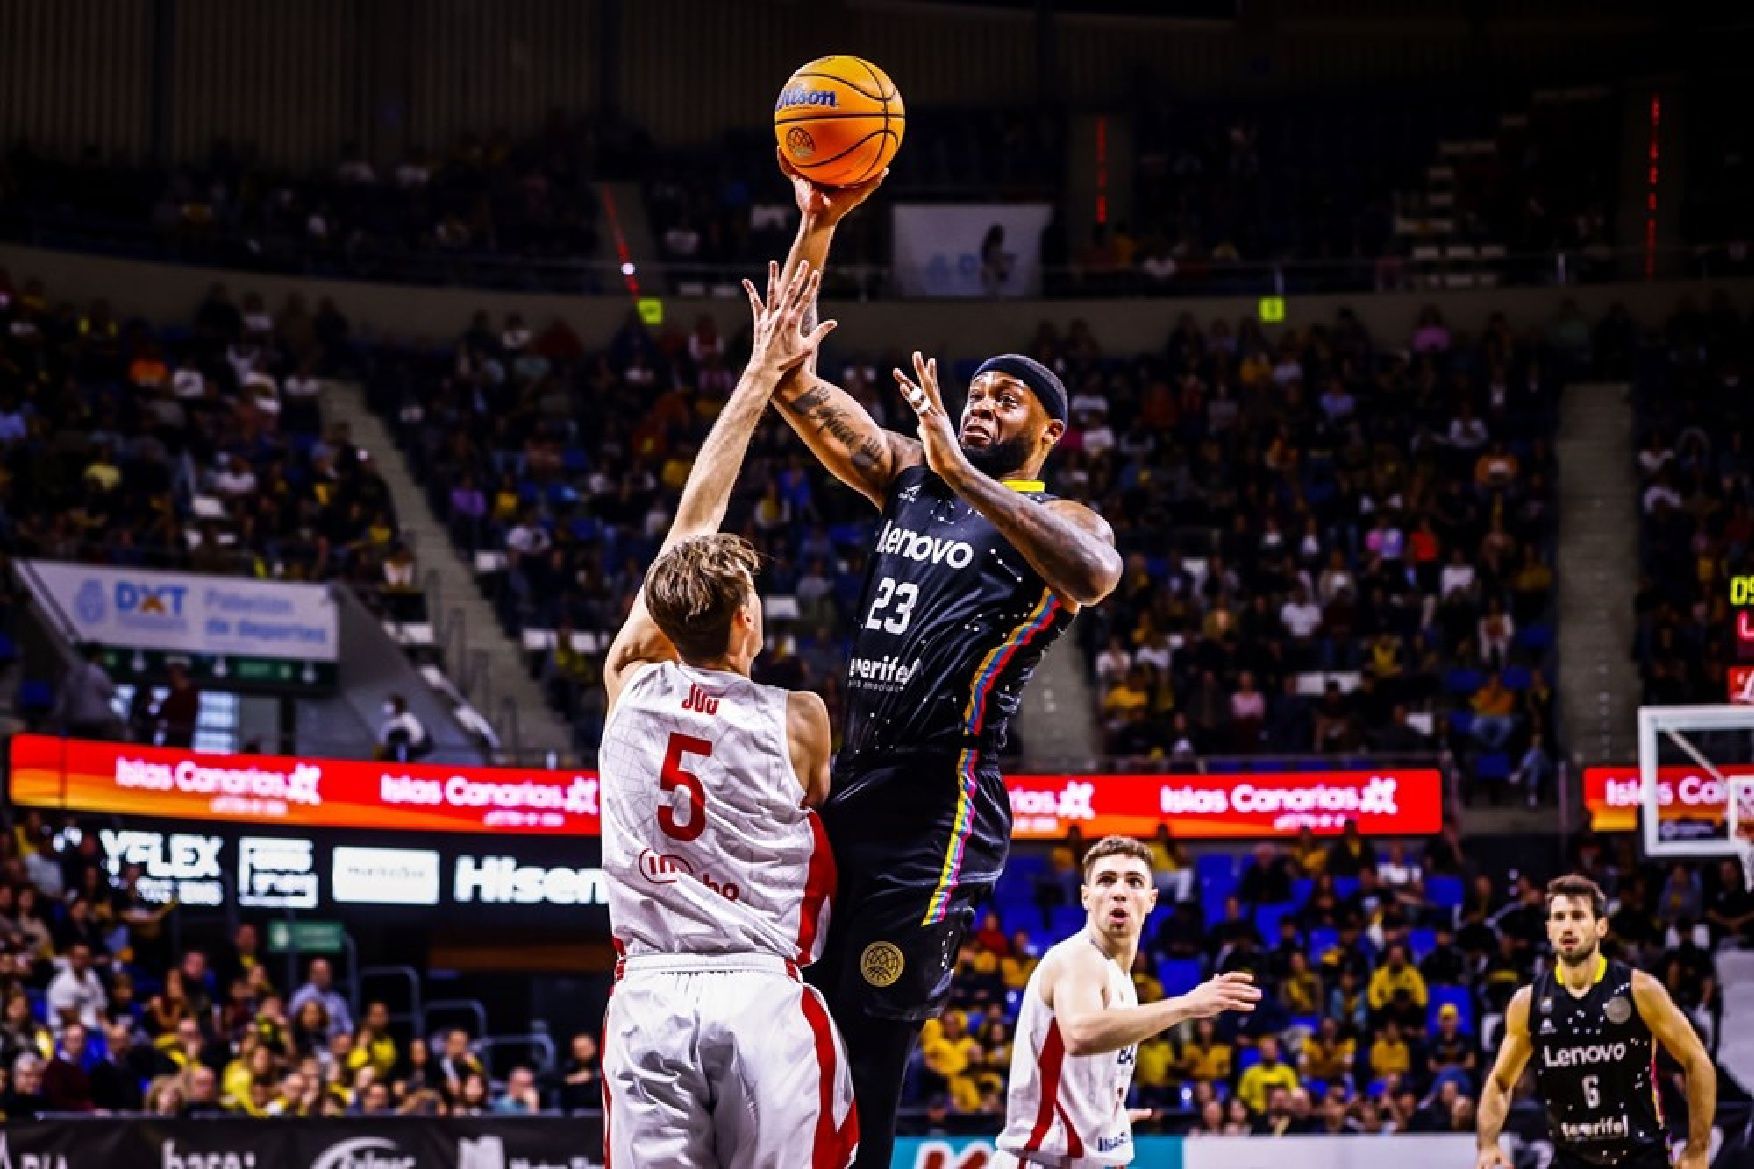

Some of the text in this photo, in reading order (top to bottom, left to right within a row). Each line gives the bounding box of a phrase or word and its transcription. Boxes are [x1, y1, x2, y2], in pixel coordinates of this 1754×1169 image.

[865, 577, 920, 636] 23
[115, 755, 287, 799] Islas Canarias
[380, 773, 562, 808] Islas Canarias
[657, 730, 713, 842] 5
[1160, 784, 1358, 813] Islas Canarias
[1543, 1043, 1626, 1068] Lenovo
[1581, 1075, 1599, 1109] 6
